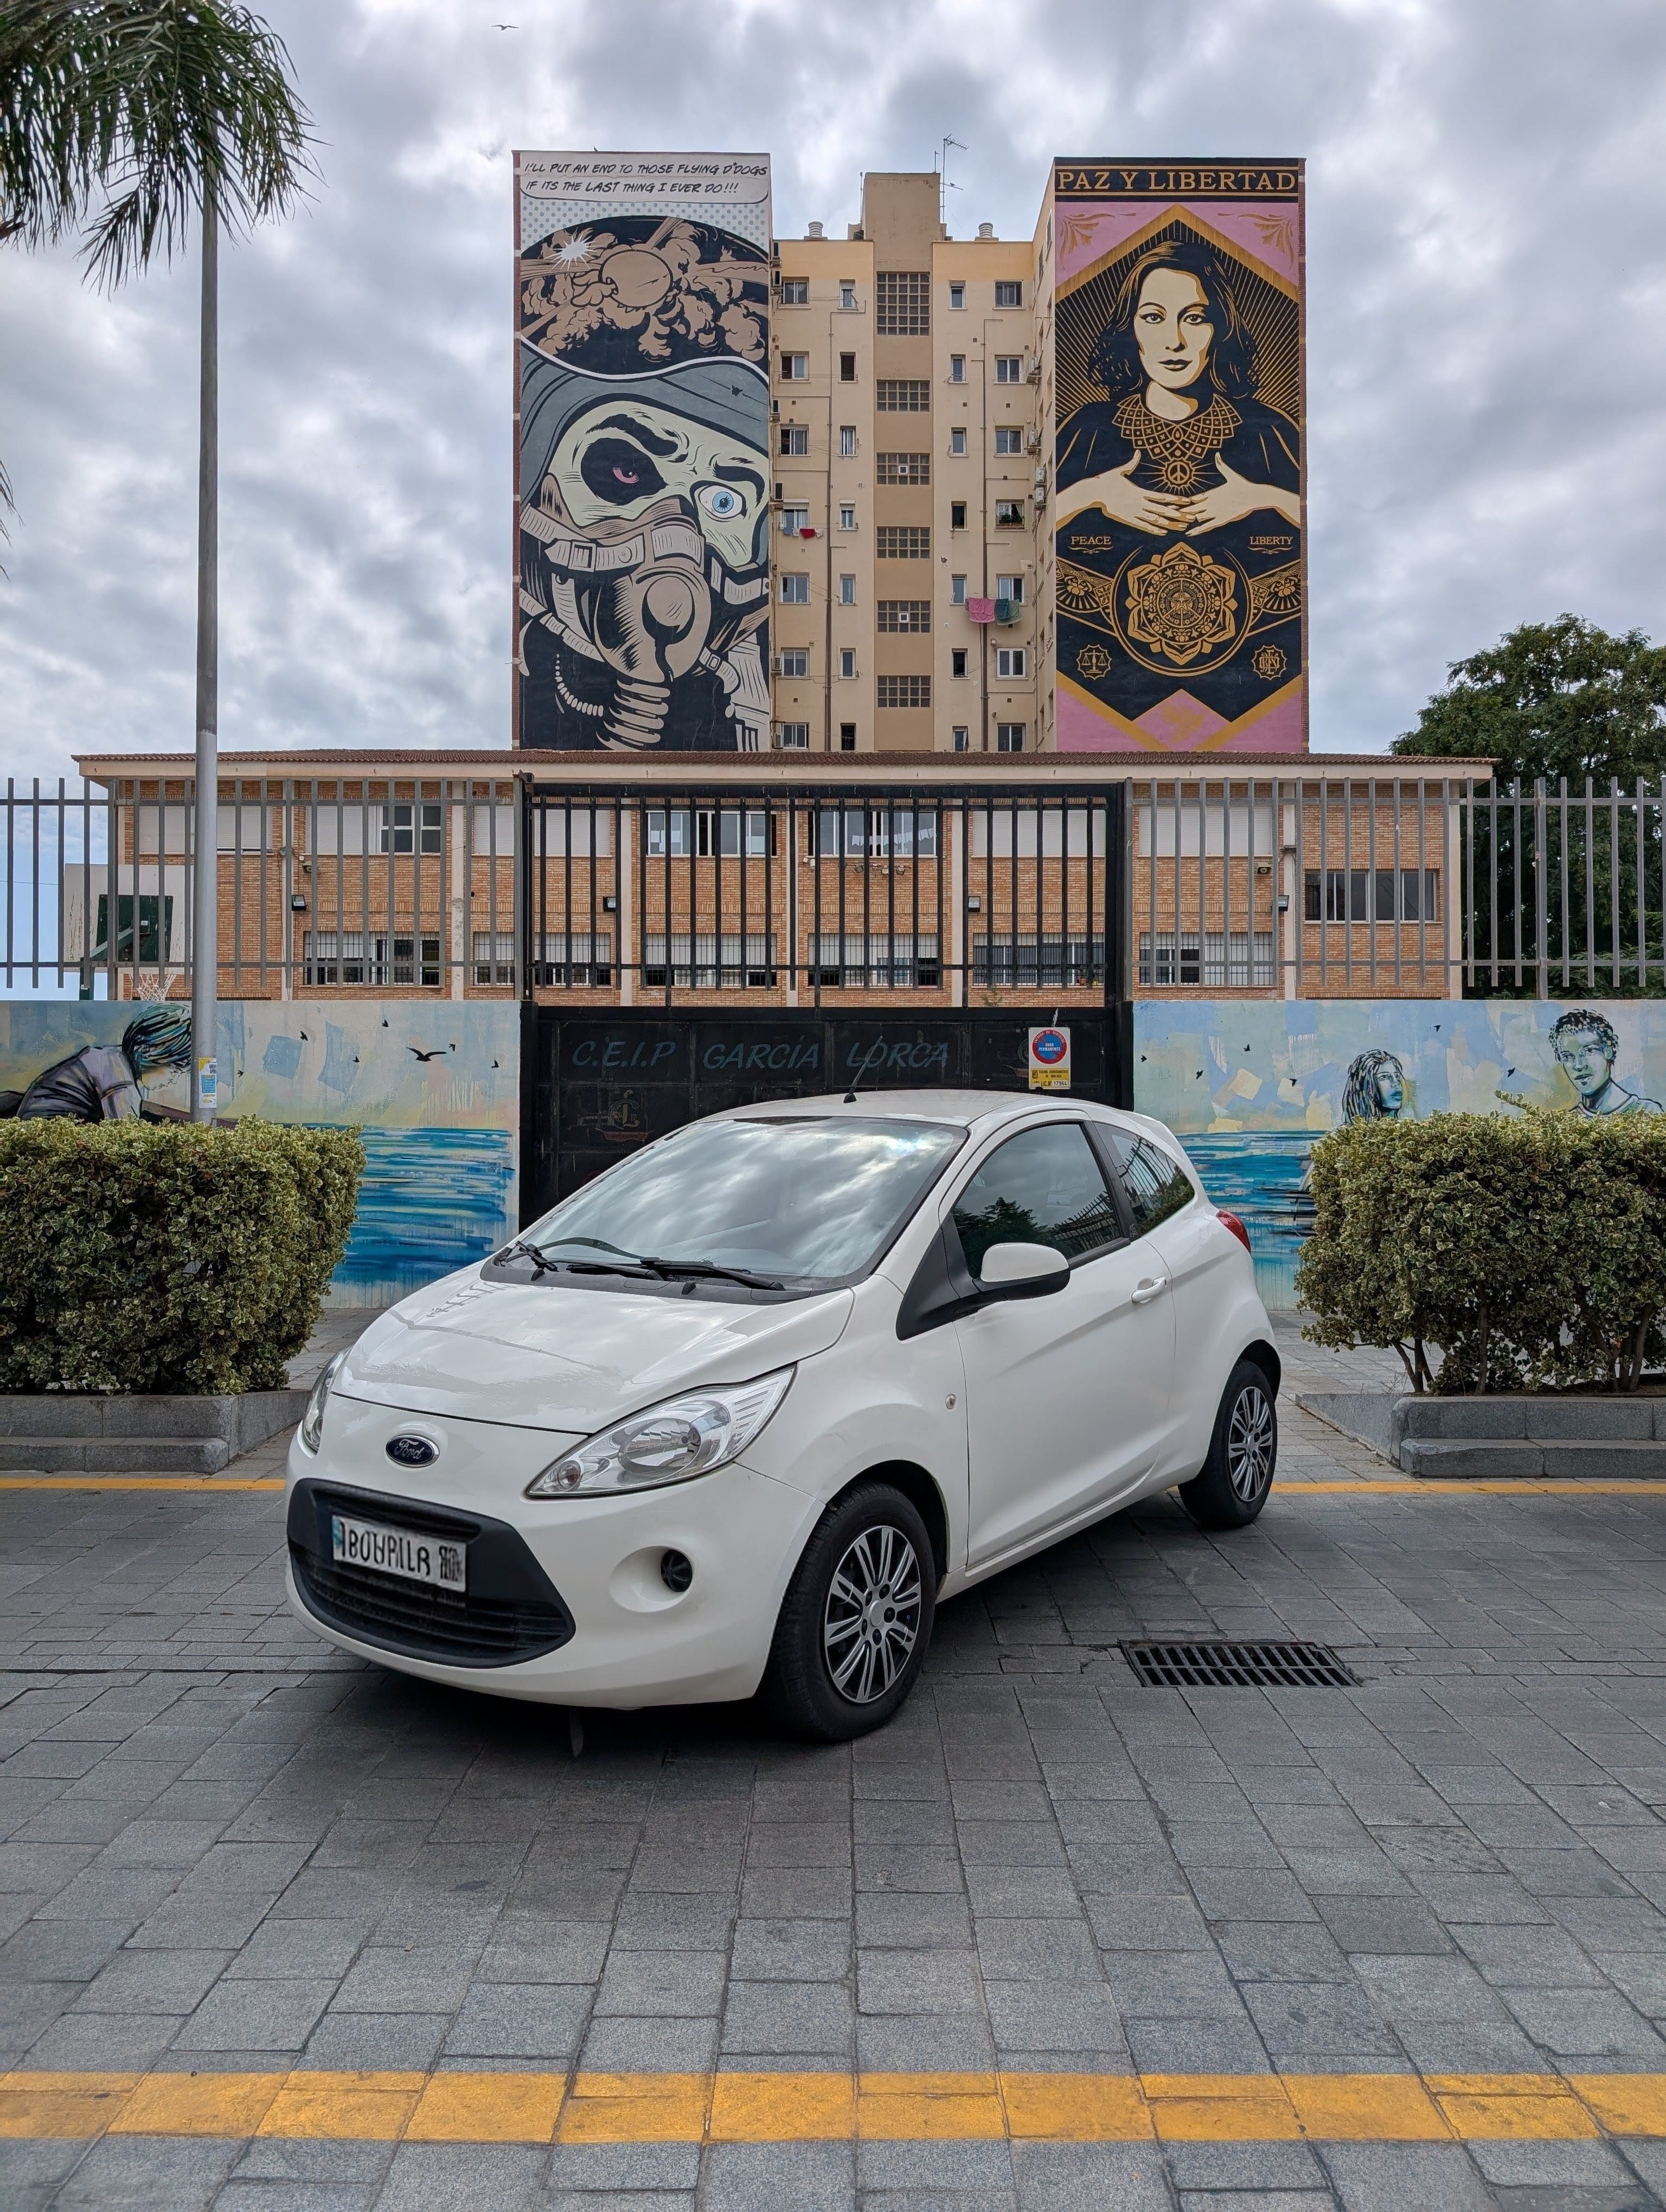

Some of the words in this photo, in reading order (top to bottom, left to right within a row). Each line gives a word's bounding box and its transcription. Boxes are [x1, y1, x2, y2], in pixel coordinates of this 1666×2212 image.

[524, 163, 546, 172] I'LL
[549, 163, 572, 173] PUT
[573, 164, 590, 173] AN
[592, 164, 617, 174] END
[619, 164, 633, 174] TO
[637, 164, 674, 174] THOSE
[677, 164, 720, 175] FLYING
[1057, 172, 1111, 190] PAZ
[1120, 172, 1139, 190] Y
[1148, 171, 1296, 190] LIBERTAD
[526, 181, 539, 190] IF
[541, 181, 559, 190] ITS
[562, 181, 583, 191] THE
[585, 181, 621, 192] LAST
[623, 183, 656, 194] THING
[657, 182, 668, 192] I
[670, 183, 702, 193] EVER
[704, 182, 739, 193] DO!!!
[1071, 536, 1112, 545] PEACE
[1249, 536, 1293, 545] LIBERTY
[572, 1040, 677, 1067] C.E.I.P
[703, 1035, 819, 1069] GARCÍA
[846, 1041, 949, 1068] LORCA
[394, 1438, 425, 1459] Ford
